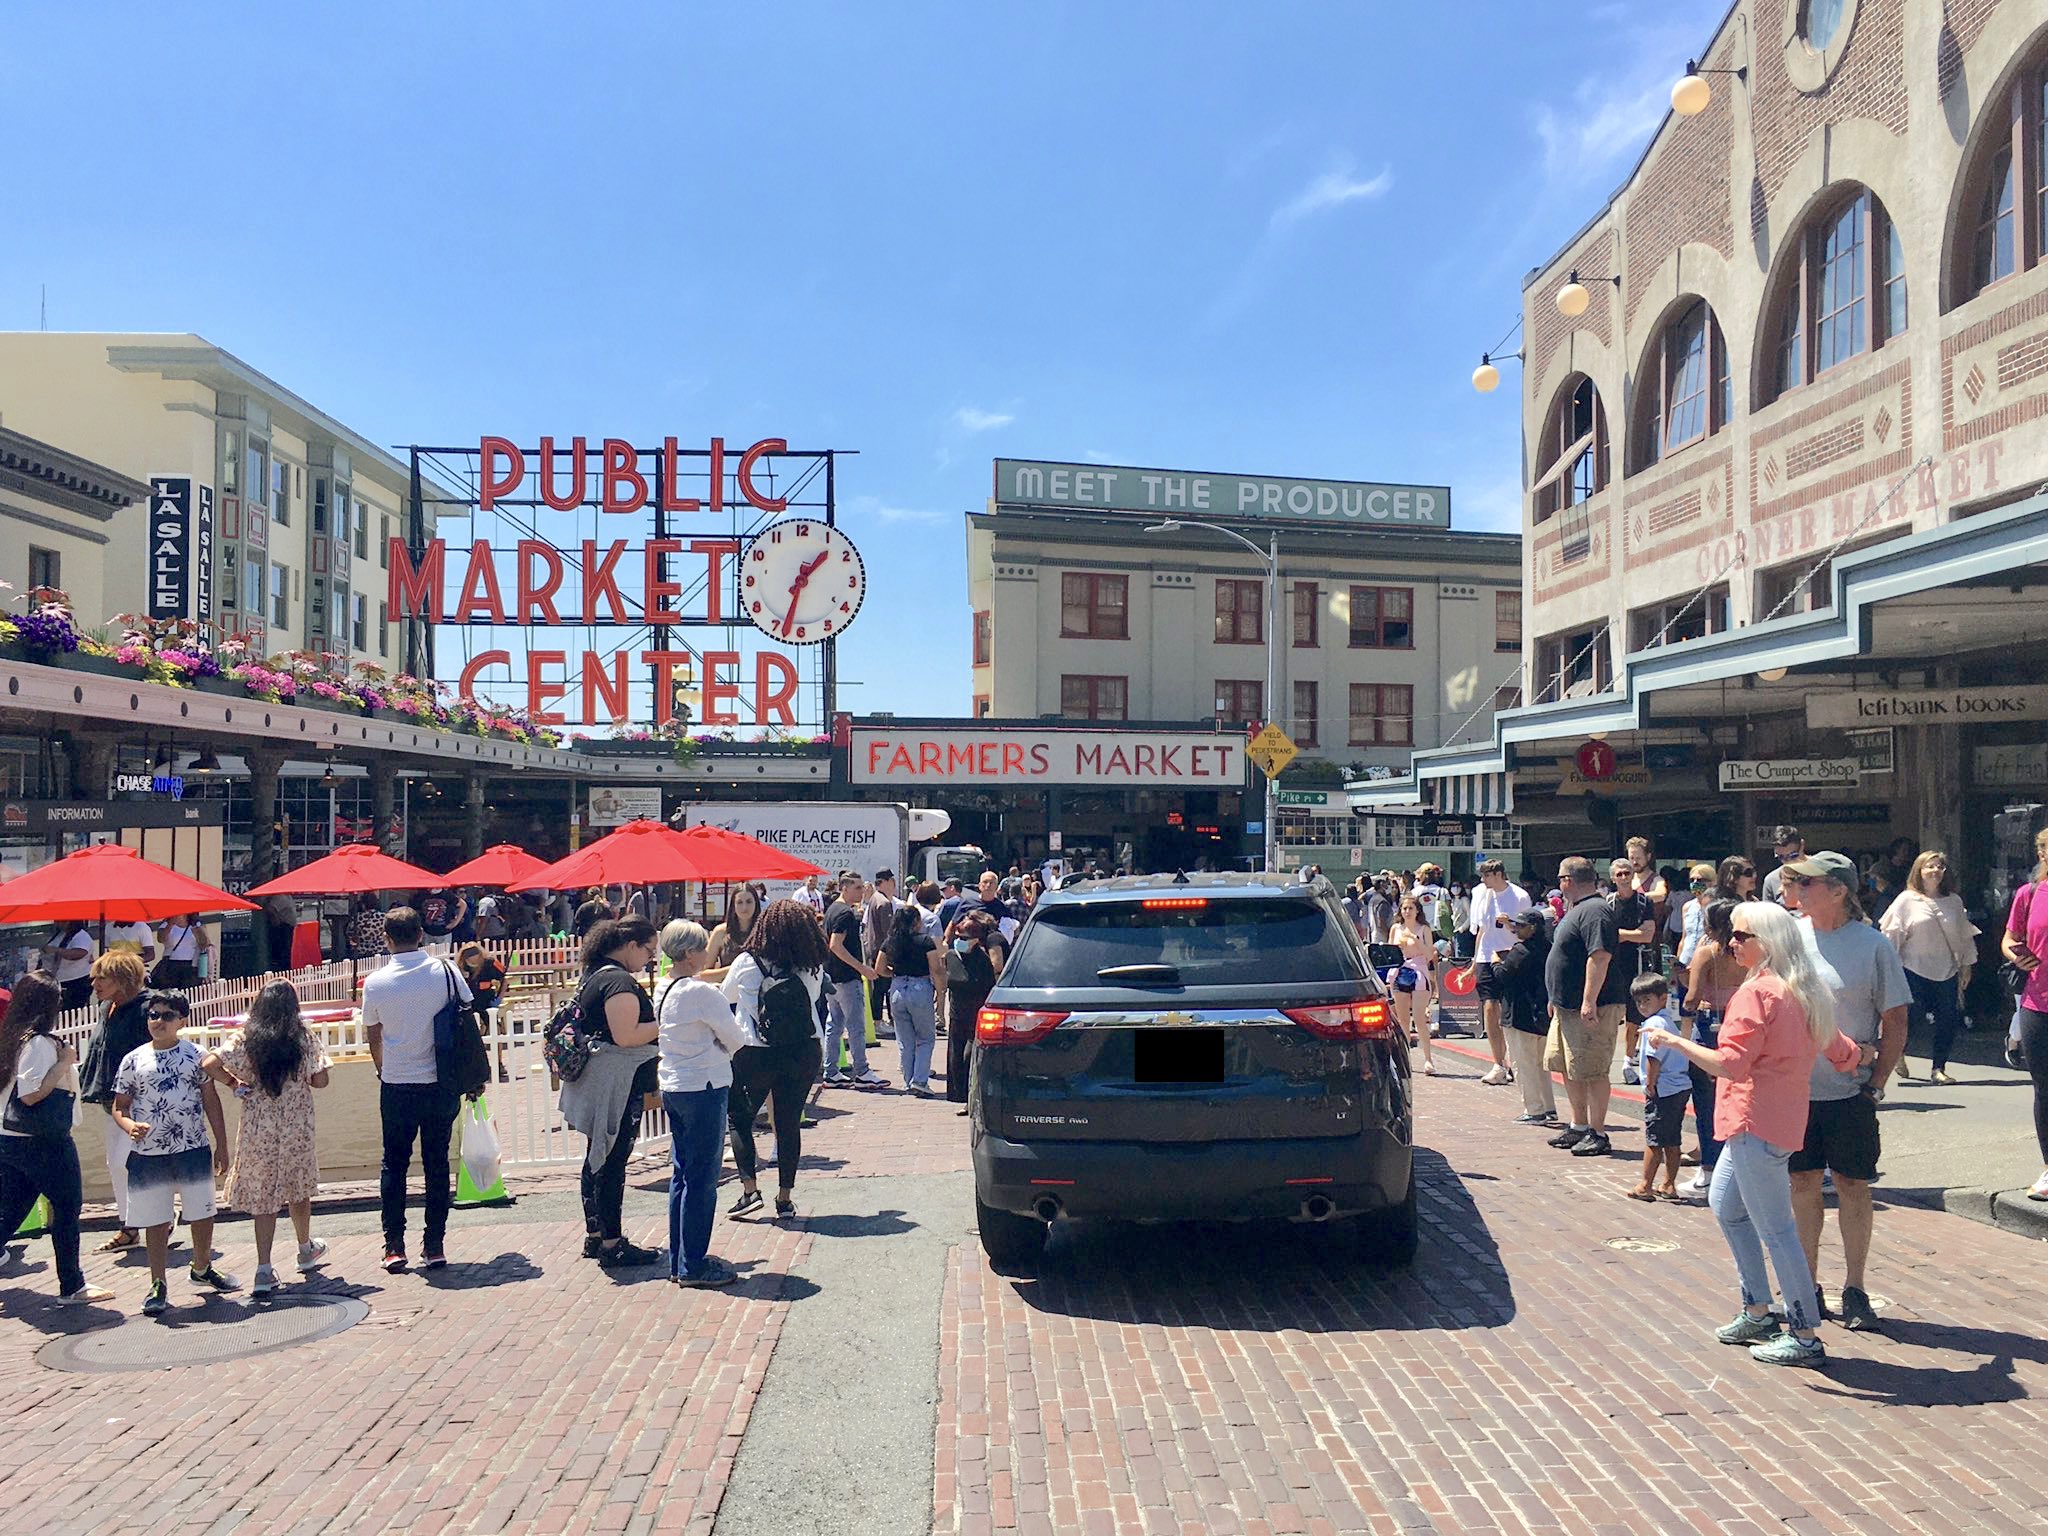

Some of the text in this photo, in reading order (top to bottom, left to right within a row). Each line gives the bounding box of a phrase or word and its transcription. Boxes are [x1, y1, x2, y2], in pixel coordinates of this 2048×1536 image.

[480, 436, 788, 514] PUBLIC
[155, 482, 182, 515] LA
[1016, 467, 1436, 521] MEET THE PRODUCER
[200, 487, 211, 523] LA
[1696, 441, 2004, 583] CORNER MARKET
[796, 524, 809, 537] 12
[771, 531, 781, 544] 11
[825, 531, 830, 544] 1
[752, 549, 765, 562] 10
[842, 550, 851, 562] 2
[154, 522, 182, 608] SALLE
[199, 532, 211, 614] SALLE
[387, 536, 740, 625] MARKET
[746, 575, 755, 587] 9
[848, 575, 857, 588] 3
[752, 601, 762, 613] 8
[839, 601, 850, 613] 4
[771, 619, 781, 632] 7
[796, 626, 806, 638] 6
[823, 619, 833, 632] 5
[458, 650, 799, 727] CENTER
[1892, 697, 1948, 715] bank
[1956, 694, 2026, 713] books
[1251, 747, 1292, 755] PEDESTRIANS
[867, 741, 1233, 776] FARMERS MARKET
[1726, 760, 1854, 780] The Crumpet Shop
[116, 775, 152, 792] CHASE
[1280, 792, 1300, 802] Pike
[48, 807, 200, 820] INFORMATION bank
[756, 829, 876, 843] PIKE PLACE FISH
[1014, 1115, 1065, 1124] TRAVERSE
